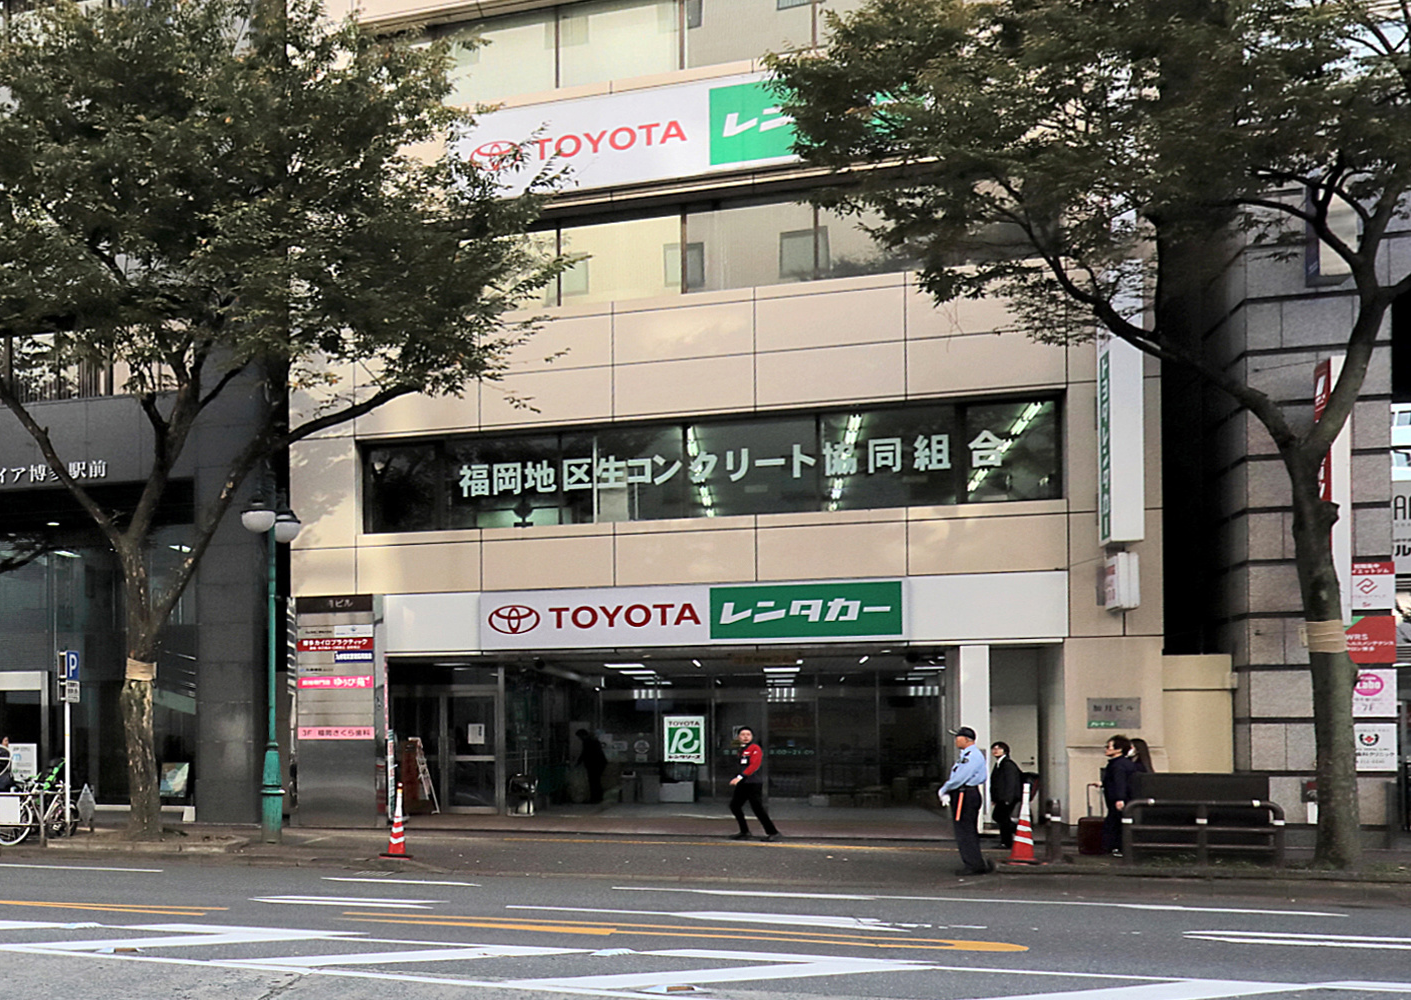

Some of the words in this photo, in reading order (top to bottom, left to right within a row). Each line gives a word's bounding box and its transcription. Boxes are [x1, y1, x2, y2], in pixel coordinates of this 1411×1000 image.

[536, 120, 688, 161] TOYOTA
[458, 428, 1008, 498] 福岡地区生コンクリート協同組合
[548, 602, 702, 630] TOYOTA
[719, 597, 891, 626] レンタカー
[69, 654, 78, 677] P
